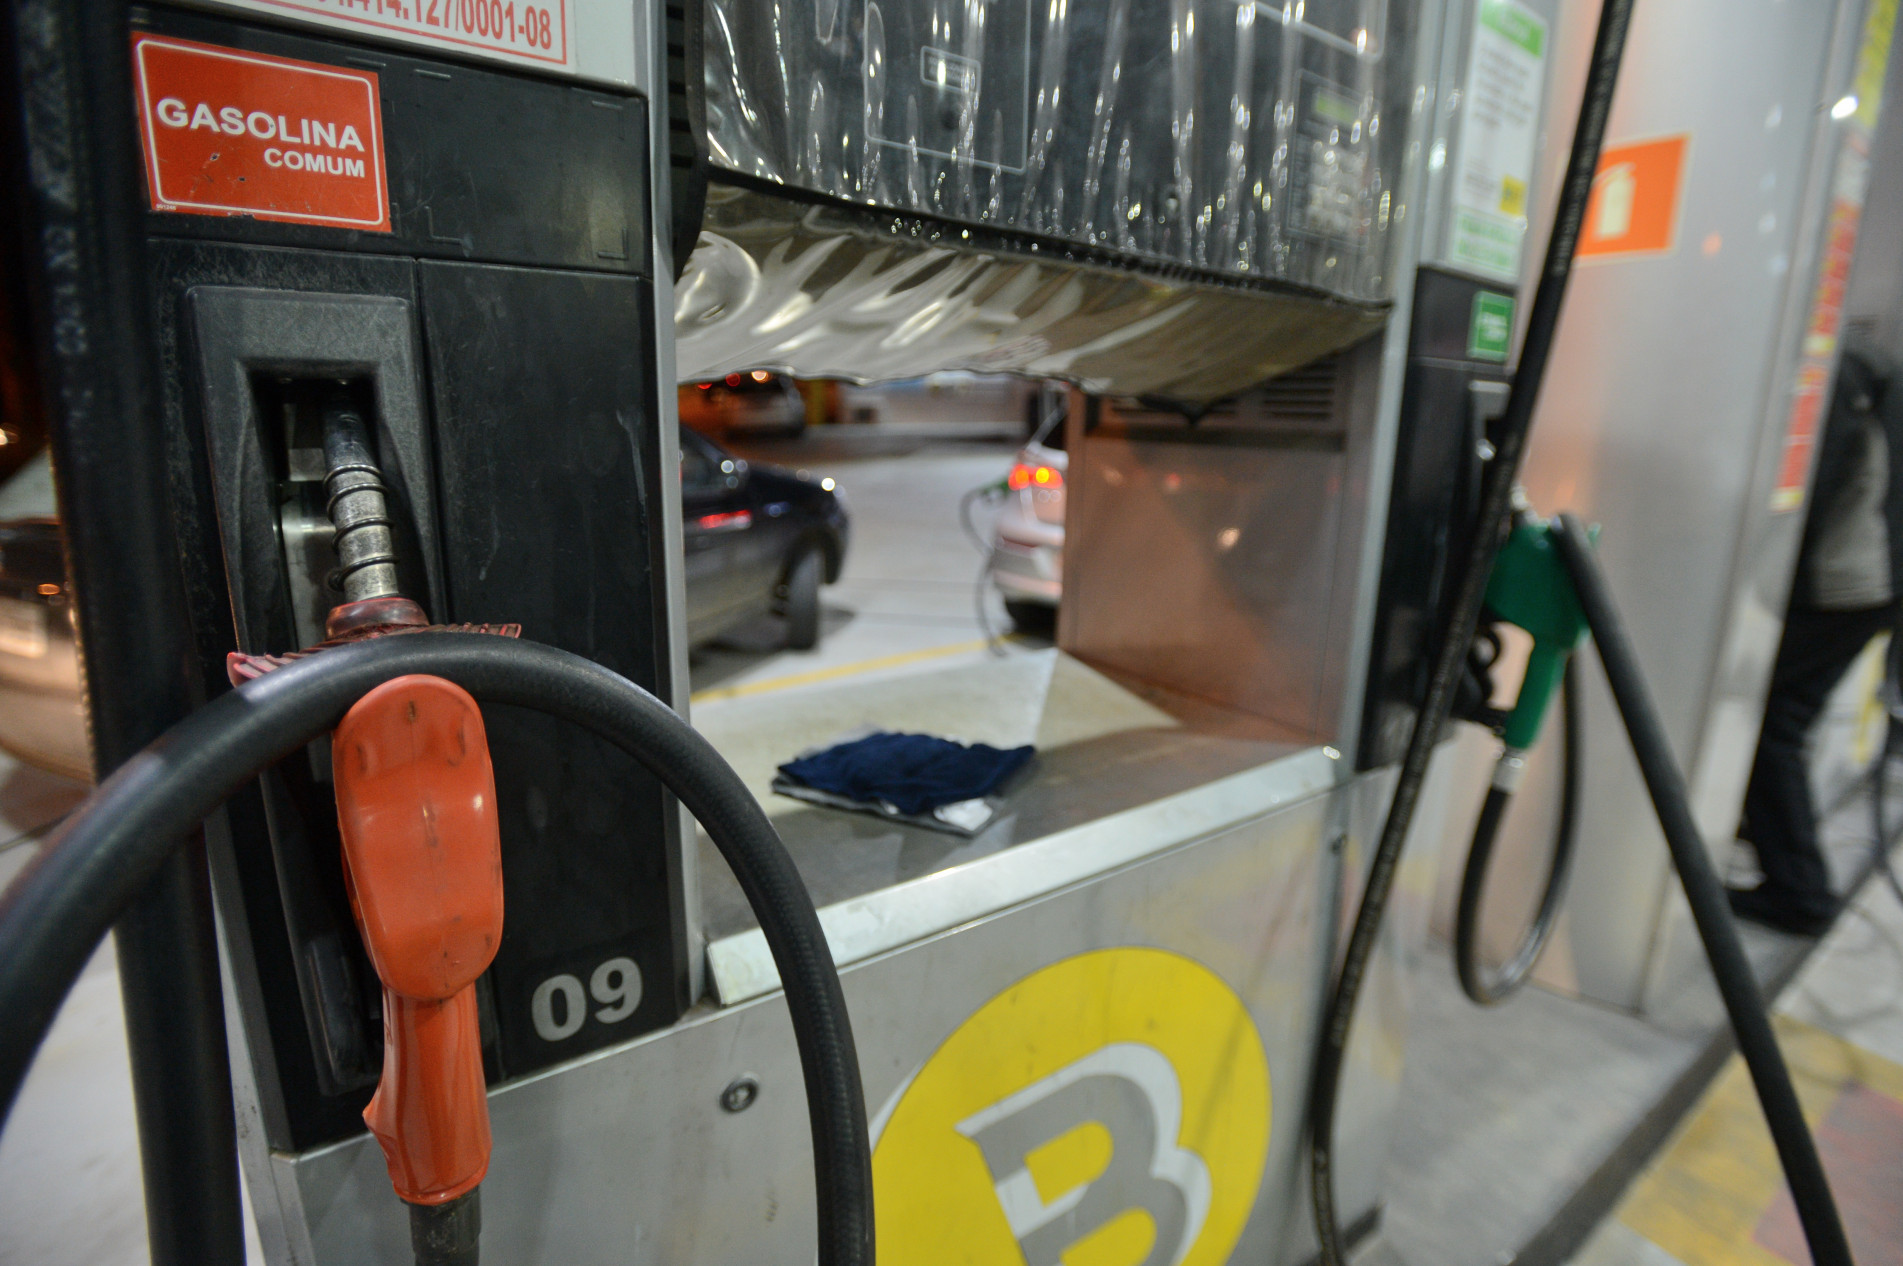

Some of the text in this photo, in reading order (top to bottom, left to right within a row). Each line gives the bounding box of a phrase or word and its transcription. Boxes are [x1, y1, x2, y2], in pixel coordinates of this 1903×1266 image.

[318, 0, 552, 50] ..127/0001-08
[157, 98, 366, 153] GASOLINA
[264, 148, 366, 179] COMUM
[531, 956, 643, 1042] 09
